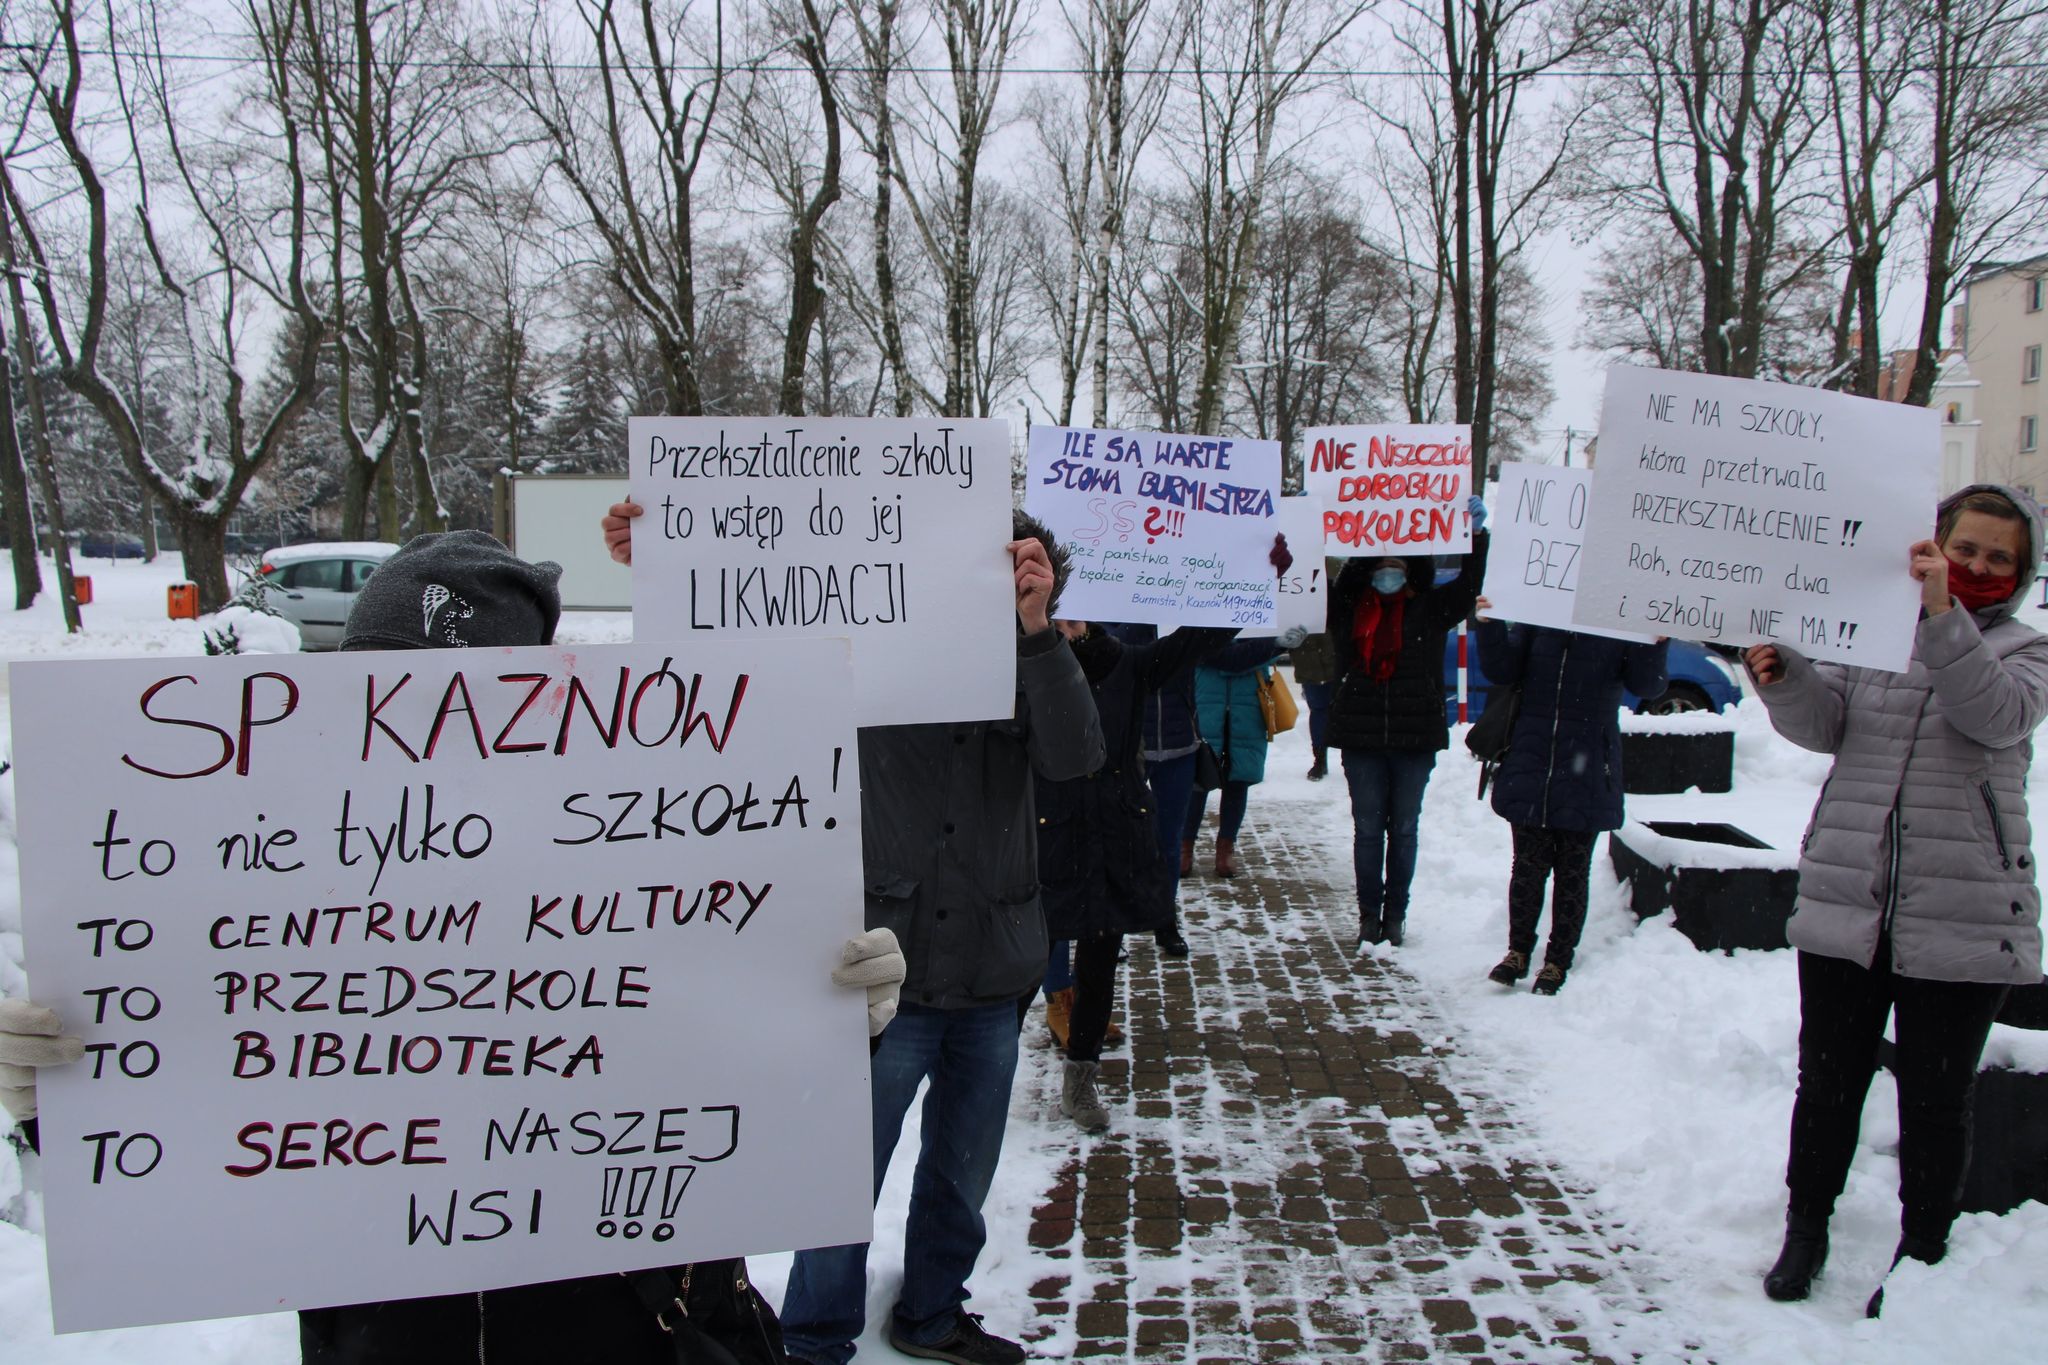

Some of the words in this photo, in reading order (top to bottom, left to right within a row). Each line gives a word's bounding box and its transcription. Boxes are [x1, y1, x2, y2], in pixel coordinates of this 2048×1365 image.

[1647, 393, 1676, 424] NIE
[1692, 398, 1722, 428] MA
[1063, 432, 1097, 458] ILE
[1154, 440, 1234, 471] WARTE
[1310, 437, 1357, 472] NIE
[1137, 471, 1275, 518] BURMISTRZA
[1338, 471, 1460, 503] DOROBKU
[1515, 478, 1556, 529] NIC
[661, 494, 694, 540] to
[712, 495, 783, 551] wstęp
[809, 488, 843, 537] do
[866, 494, 904, 544] jej
[1068, 541, 1095, 558] Bez
[1102, 547, 1169, 566] państwa
[1181, 552, 1225, 579] zgody
[1079, 565, 1125, 584] będzie
[1135, 570, 1190, 597] żadnej
[1523, 538, 1582, 592] BEZ
[1681, 558, 1763, 584] czasem
[1784, 564, 1831, 595] dwa
[690, 563, 907, 630] LIKWIDACJI
[1618, 595, 1628, 618] i
[1750, 608, 1783, 639] NIE
[121, 670, 301, 779] SP
[361, 657, 749, 763] KAZNÓW
[93, 809, 176, 881] to
[217, 814, 305, 873] nie
[335, 784, 493, 896] tylko
[77, 918, 153, 957] TO
[209, 901, 481, 951] CENTRUM
[526, 880, 772, 943] KULTURY
[84, 985, 162, 1024] TO
[214, 965, 652, 1019] PRZEDSZKOLE
[84, 1039, 161, 1080] TO
[232, 1031, 604, 1080] BIBLIOTEKA
[82, 1130, 163, 1185] TO
[223, 1119, 448, 1178] SERCE
[484, 1105, 741, 1163] NASZEJ
[408, 1188, 541, 1247] WSI
